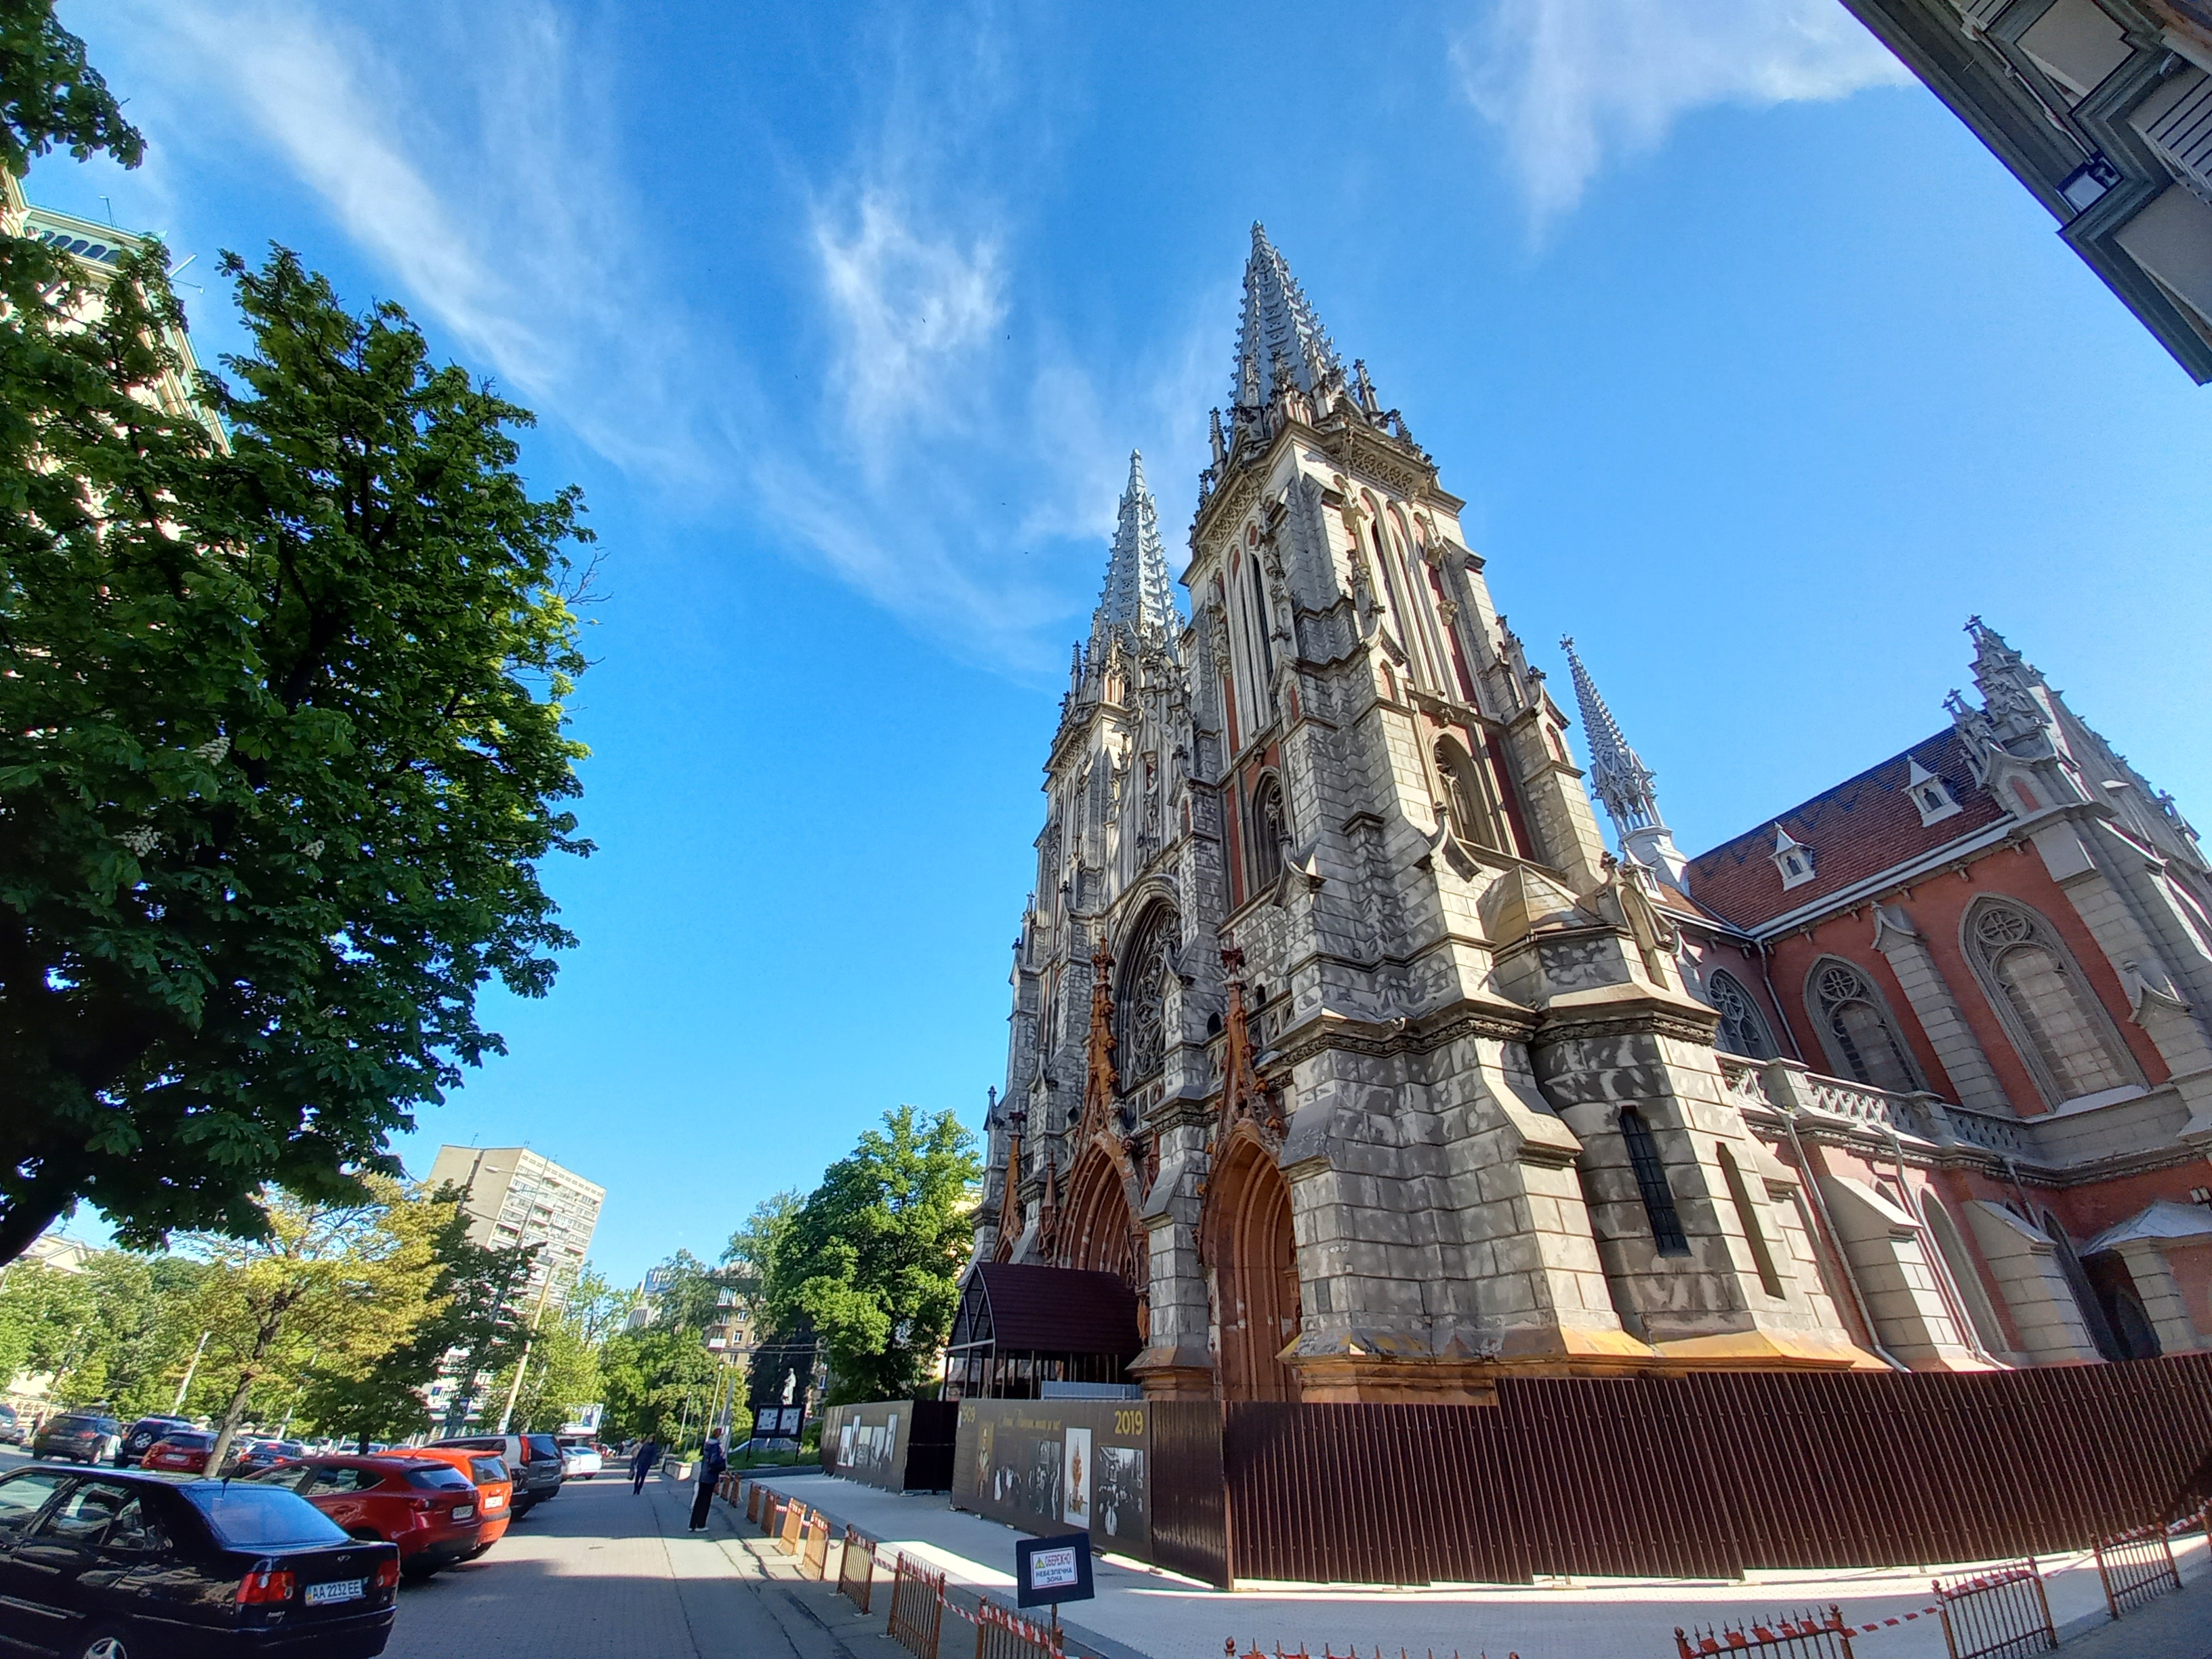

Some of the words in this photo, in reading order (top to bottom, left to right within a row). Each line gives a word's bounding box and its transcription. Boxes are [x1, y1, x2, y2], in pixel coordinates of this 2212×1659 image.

[1114, 1410, 1144, 1435] 2019
[1036, 1567, 1073, 1578] НЕБЕЗПЕЧНА
[1046, 1575, 1063, 1583] ЗОНА
[312, 1586, 325, 1599] AA
[327, 1583, 347, 1598] 2232
[348, 1581, 361, 1595] EE
